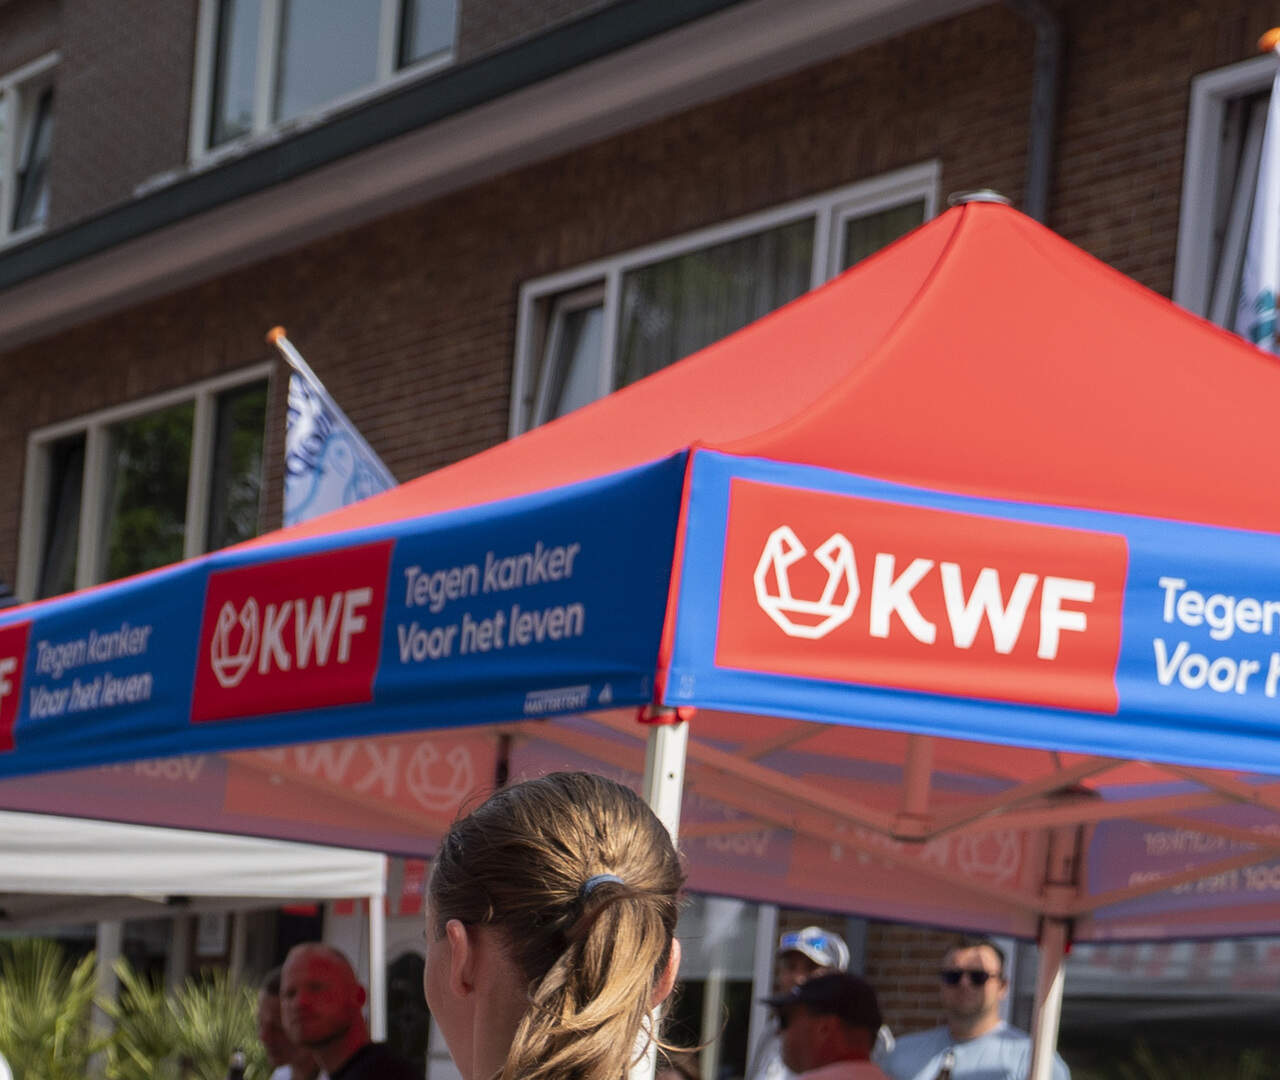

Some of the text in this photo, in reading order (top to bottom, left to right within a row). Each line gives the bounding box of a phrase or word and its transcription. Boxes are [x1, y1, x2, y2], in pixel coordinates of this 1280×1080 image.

[405, 540, 581, 613] Tegen kanker
[868, 551, 1096, 661] KWF
[35, 621, 153, 679] Tegen kanker
[258, 586, 373, 675] KWF
[397, 602, 585, 664] Voor het leven
[29, 672, 153, 720] Voor het leven
[1153, 637, 1260, 695] Voor
